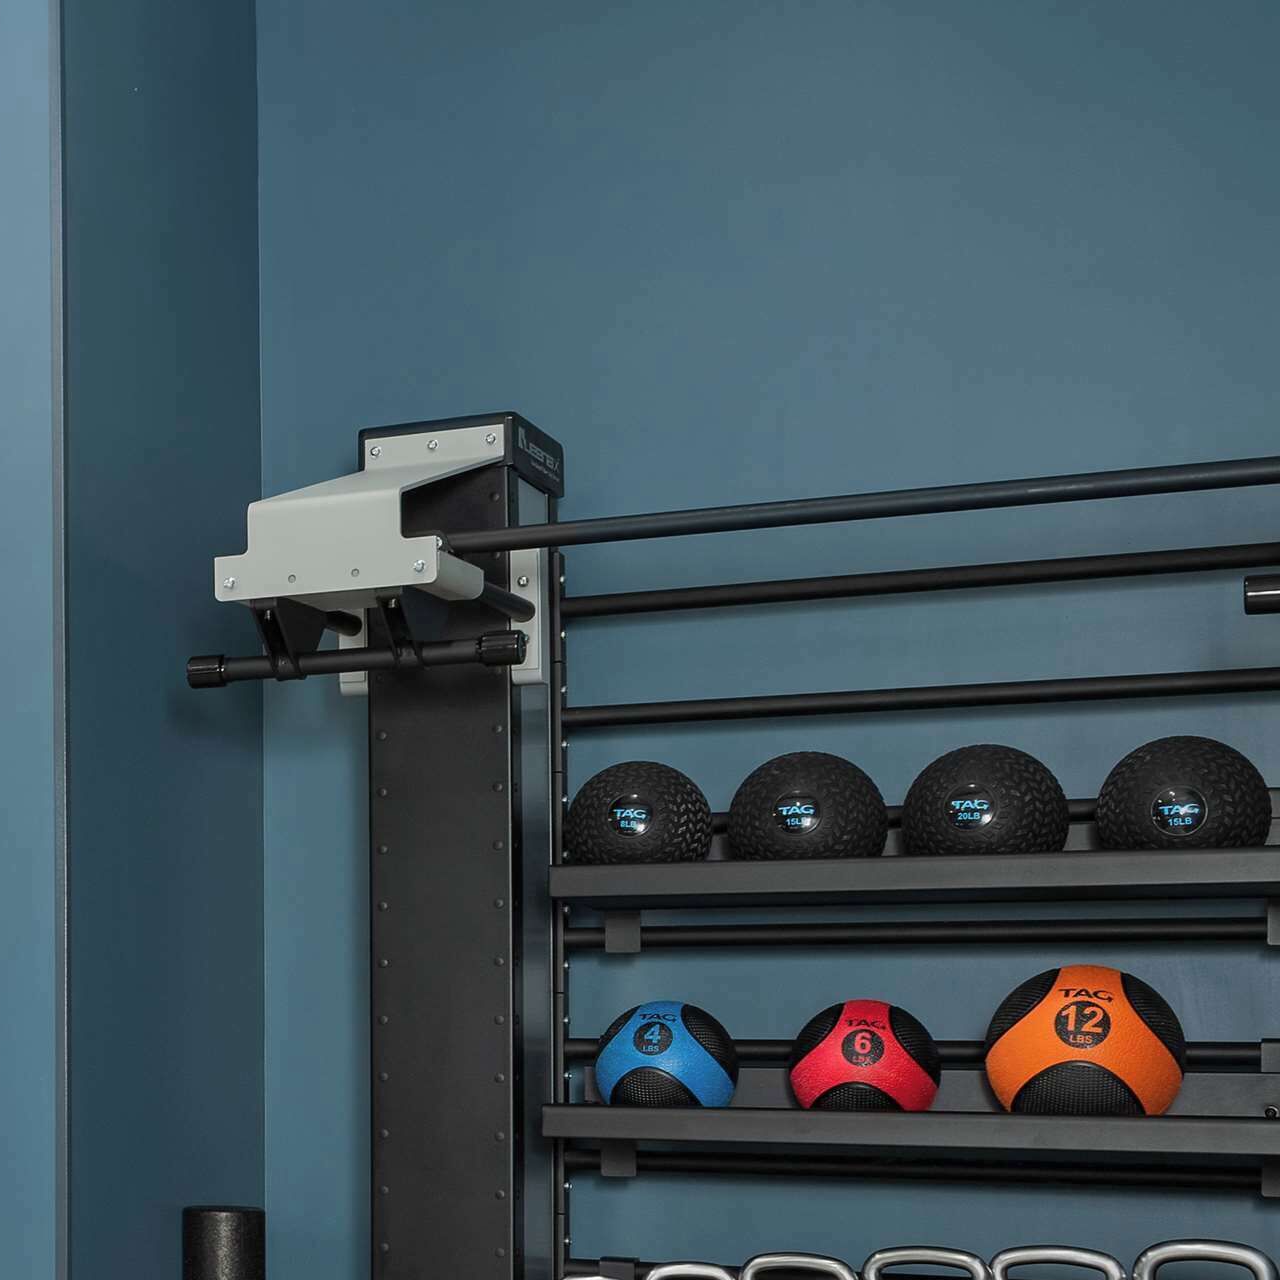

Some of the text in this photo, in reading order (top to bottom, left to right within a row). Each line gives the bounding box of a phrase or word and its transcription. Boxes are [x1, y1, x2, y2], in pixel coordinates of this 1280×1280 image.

[778, 804, 815, 815] TAG
[951, 799, 989, 810] TAG
[1159, 803, 1200, 815] TAG
[613, 808, 647, 819] TAG
[958, 812, 980, 820] 20LB
[1058, 988, 1113, 1002] TAG
[640, 1013, 676, 1022] TAG
[1061, 1005, 1104, 1033] 12
[845, 1019, 886, 1030] TAG
[645, 1023, 660, 1043] 4
[854, 1031, 871, 1054] 6
[1070, 1035, 1093, 1044] LBS
